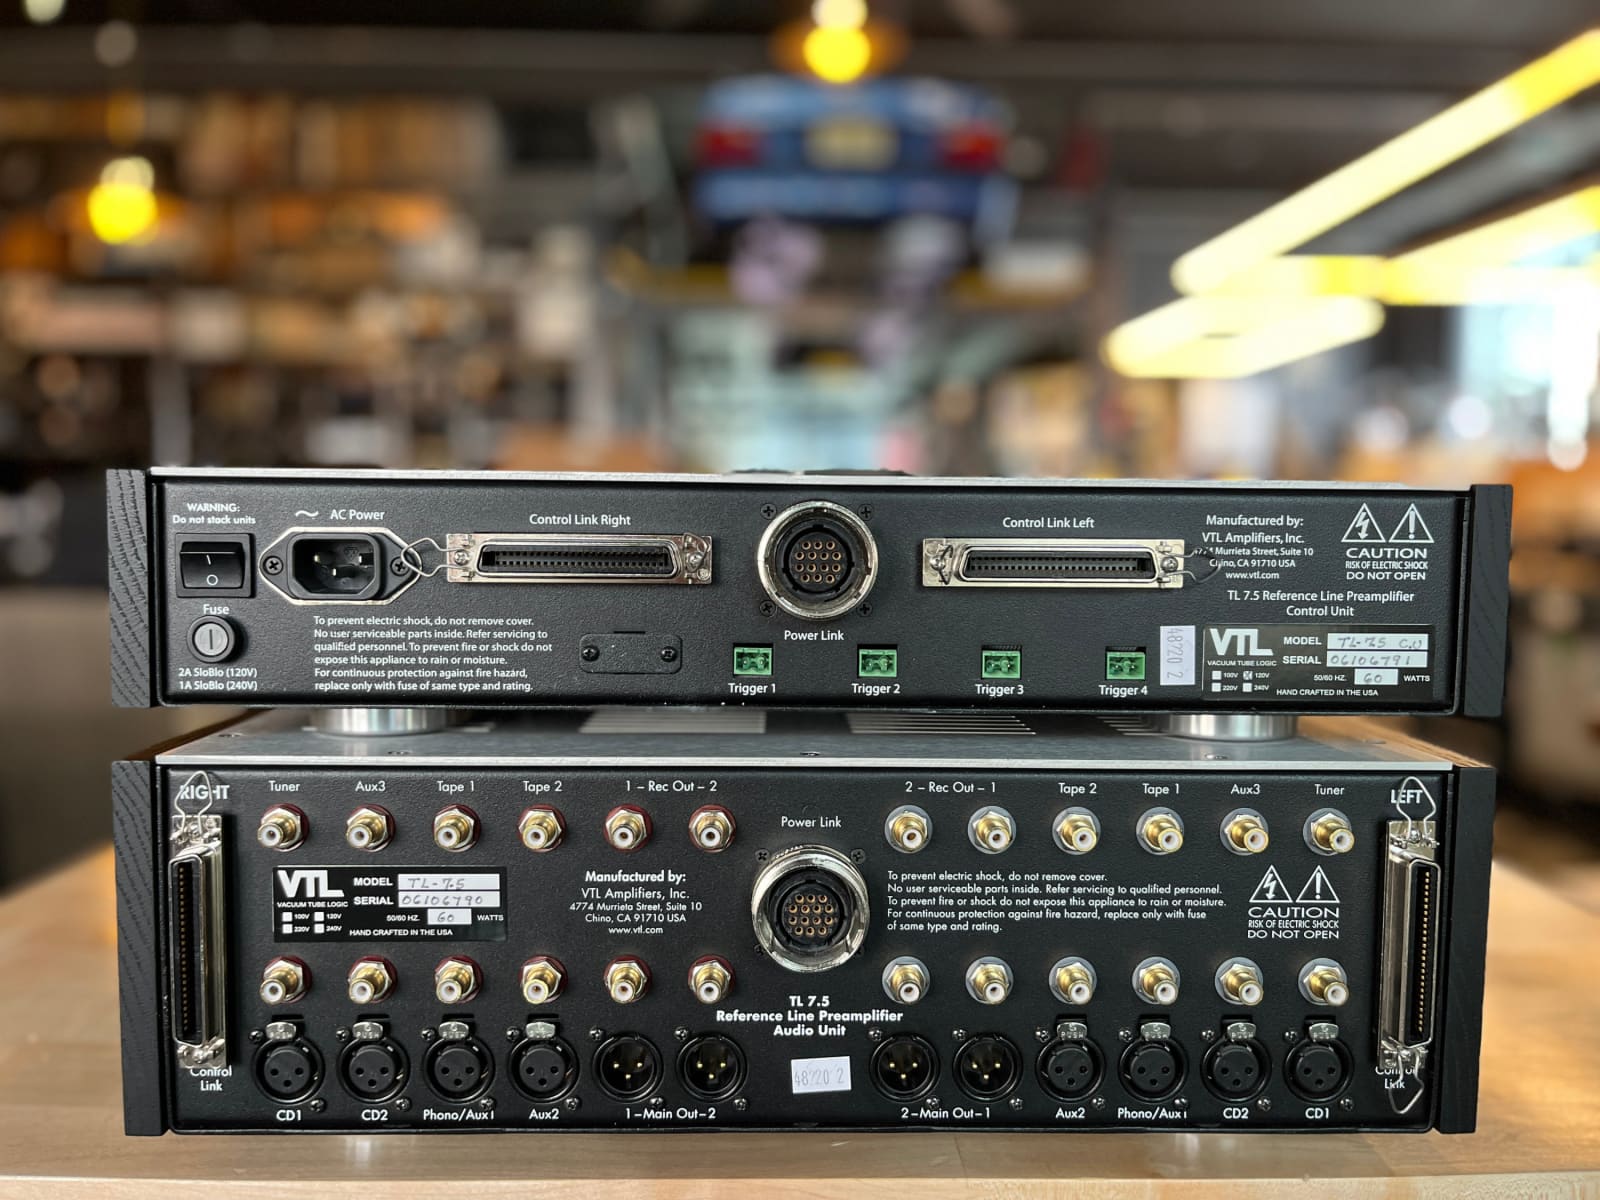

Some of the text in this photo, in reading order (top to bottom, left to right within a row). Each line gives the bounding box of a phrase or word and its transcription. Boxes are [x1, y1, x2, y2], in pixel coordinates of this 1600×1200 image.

[186, 502, 240, 513] WARNING:
[330, 508, 385, 520] AC Power
[172, 513, 256, 525] Do not stack units
[529, 513, 631, 528] Control Link Right
[1003, 516, 1095, 528] Control Link Left
[1206, 513, 1304, 527] Manufactured by:
[1202, 531, 1305, 545] VTL Amplifiers, Inc.
[1346, 547, 1427, 559] CAUTION
[1346, 570, 1426, 581] DO NOT OPEN
[1227, 589, 1415, 602] TL 7.5 Reference Line Preamplifier
[203, 603, 229, 615] Fuse
[1286, 604, 1354, 616] Control Unit
[784, 629, 844, 640] Power Link
[1283, 635, 1322, 646] MODEL
[1209, 628, 1274, 656] VTL
[1282, 655, 1322, 665] SERIAL
[1330, 655, 1410, 665] 06106791
[178, 666, 257, 678] 2A SloBlo (120V)
[1403, 674, 1430, 683] WATTS
[179, 679, 258, 691] 1A SloBlo (240V)
[314, 679, 533, 692] replace only with fuse of same type and rating.
[728, 682, 776, 696] Trigger 1
[851, 682, 900, 696] Trigger 2
[975, 683, 1024, 697] Trigger 3
[1098, 684, 1148, 698] Trigger 4
[1276, 688, 1378, 697] HAND CRAFTED IN THE USA
[179, 784, 231, 800] RIGHT
[268, 779, 300, 792] Tuner
[355, 779, 386, 792] Aux3
[437, 779, 474, 794] Tape 1
[523, 779, 562, 794] Tape 2
[648, 779, 694, 792] Rec Out
[929, 780, 974, 793] Rec Out
[1058, 781, 1097, 796] Tape 2
[1142, 782, 1179, 797] Tape 1
[1230, 782, 1260, 795] Aux3
[1314, 783, 1345, 795] Tuner
[1390, 789, 1424, 804] LEFT
[781, 815, 841, 827] Power Link
[353, 876, 393, 887] MODEL
[585, 869, 686, 885] Manufactured by:
[888, 869, 1107, 882] To prevent electric shock, do not remove cover.
[277, 870, 345, 898] VTL
[353, 895, 394, 906] SERIAL
[402, 895, 483, 906] 06106790
[581, 886, 689, 902] VTL Amplifiers, Inc.
[569, 901, 702, 912] 4774 Murrieta Street, Suite 10
[1248, 906, 1339, 918] CAUTION
[585, 912, 686, 923] Chino, CA 91710 USA
[1248, 918, 1339, 930] RISK OF ELECTRIC SHOCK
[608, 923, 663, 934] www.vtl.com
[1248, 929, 1339, 940] DO NOT OPEN
[789, 994, 830, 1007] TL 7.5
[716, 1009, 903, 1025] Reference Line Preamplifier
[773, 1023, 846, 1036] Audio Unit
[200, 1078, 222, 1091] Link
[276, 1108, 301, 1121] CD1
[361, 1108, 388, 1121] CD2
[529, 1107, 559, 1120] Aux2
[1055, 1106, 1085, 1119] Aux2
[1223, 1106, 1249, 1119] CD2
[1305, 1106, 1329, 1119] CD1
